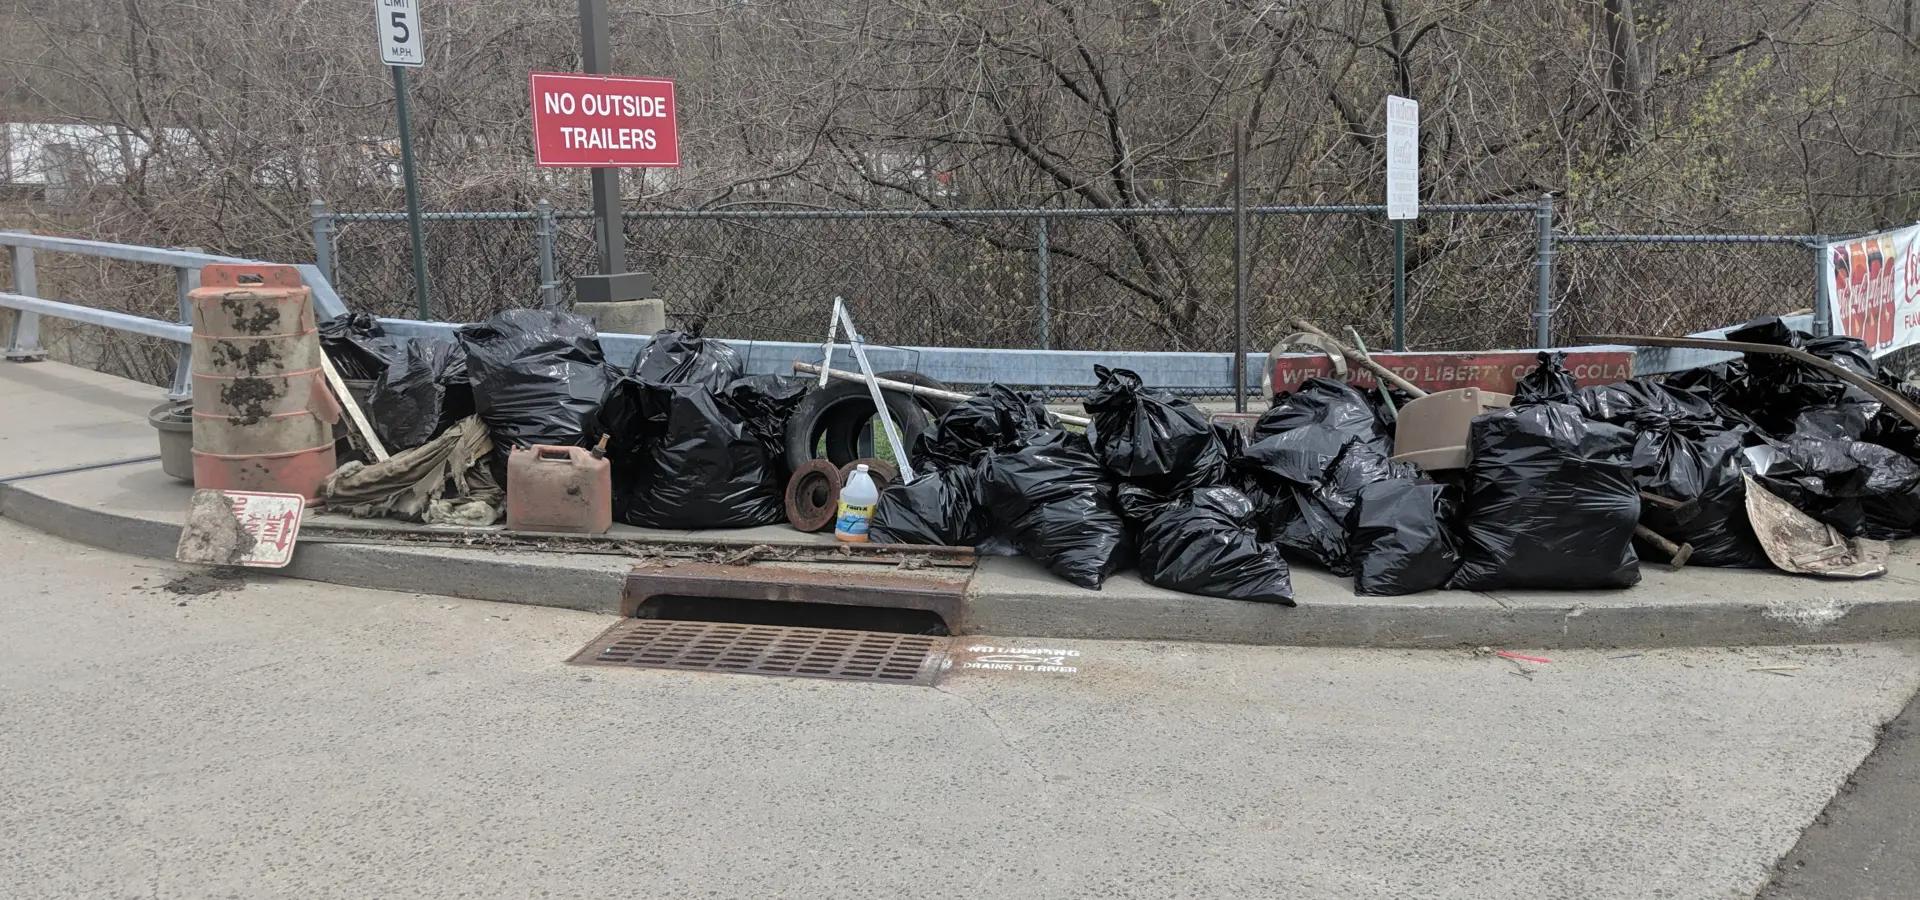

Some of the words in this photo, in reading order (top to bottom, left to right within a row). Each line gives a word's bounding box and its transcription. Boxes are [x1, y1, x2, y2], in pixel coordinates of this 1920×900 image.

[391, 11, 410, 44] 5
[544, 91, 576, 115] NO
[581, 93, 667, 118] OUTSIDE
[560, 126, 657, 150] TRAILERS
[1282, 366, 1377, 384] WELCOM
[1391, 366, 1419, 381] TO
[1423, 365, 1507, 382] LIBERTY
[261, 512, 283, 544] TIME
[967, 644, 995, 654] NO
[963, 662, 1013, 671] DRAINS
[1016, 663, 1035, 672] TO
[1037, 664, 1077, 673] RIVER
